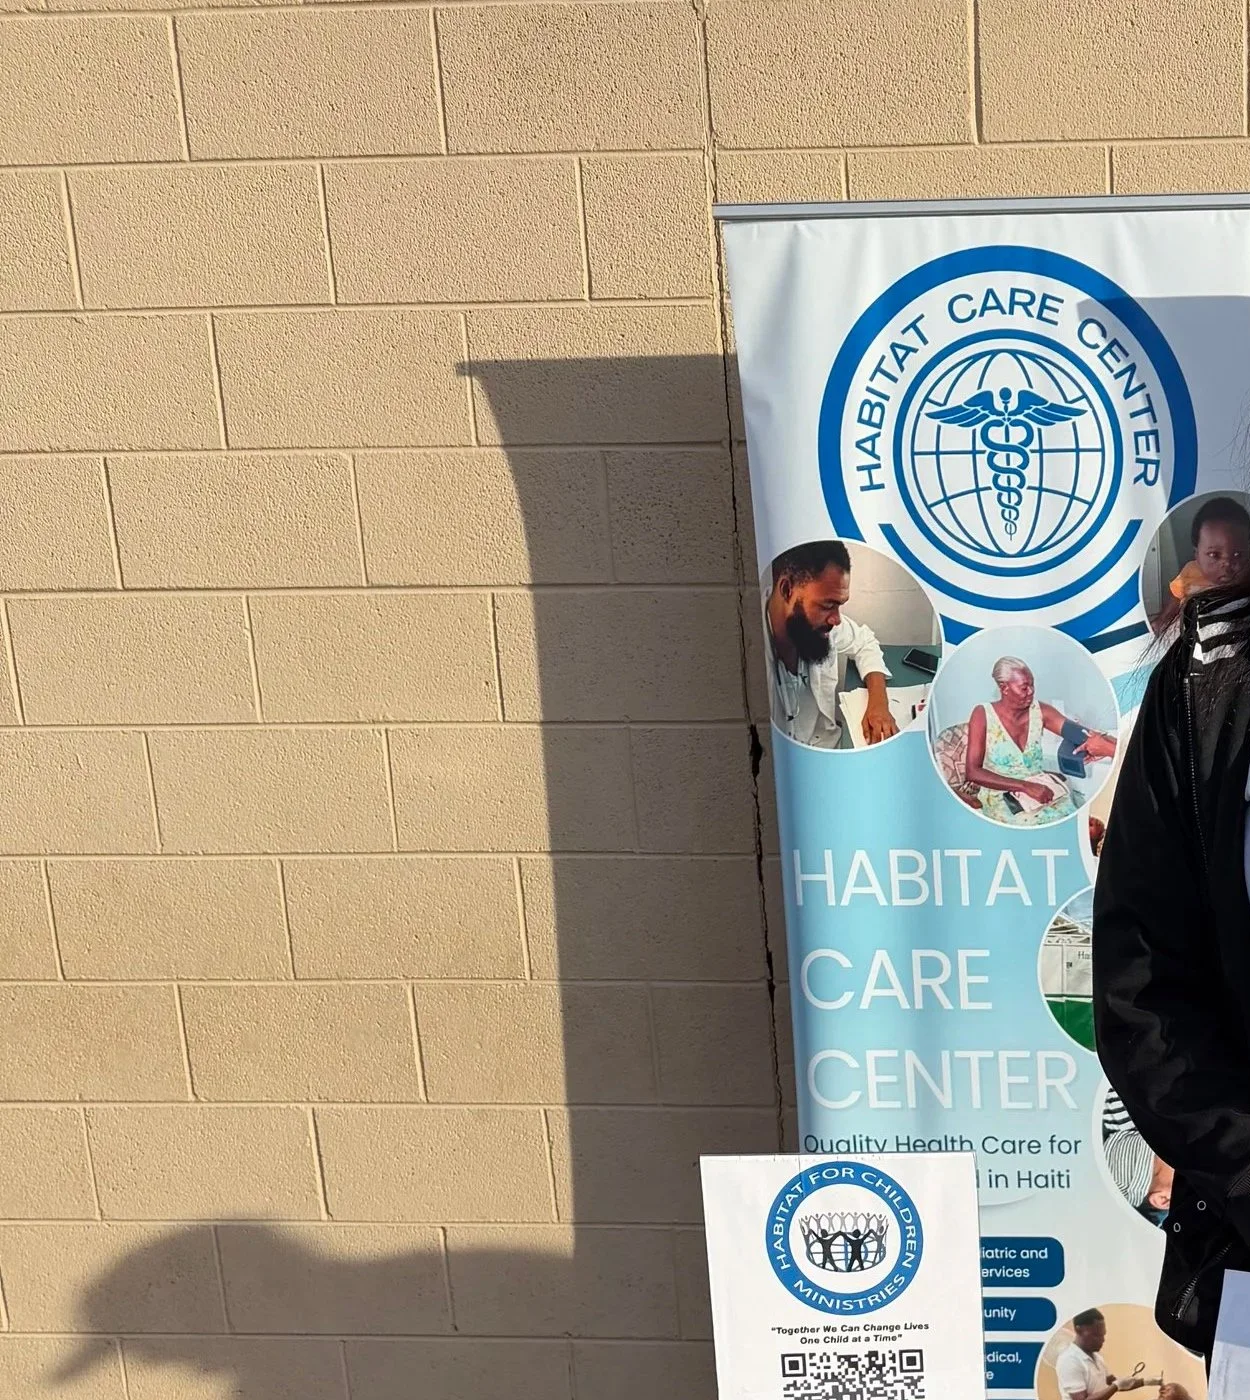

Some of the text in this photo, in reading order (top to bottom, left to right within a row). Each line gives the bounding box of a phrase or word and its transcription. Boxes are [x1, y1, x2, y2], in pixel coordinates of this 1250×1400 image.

[856, 286, 1161, 493] HABITAT CARE CENTER
[793, 848, 1069, 907] HABITAT
[801, 948, 993, 1011] CARE
[806, 1049, 1079, 1110] CENTER
[803, 1133, 1082, 1156] Quality Health Care for
[988, 1170, 1011, 1189] in
[1016, 1169, 1072, 1190] Haiti
[772, 1167, 917, 1270] HABITAT FOR CHILDREN
[981, 1247, 1049, 1260] iatric and
[981, 1267, 1030, 1278] ervices
[793, 1274, 906, 1311] MINISTRIES
[984, 1307, 1017, 1321] unity
[823, 1324, 837, 1333] We
[840, 1324, 860, 1333] Can
[863, 1323, 901, 1334] Change
[904, 1322, 930, 1331] Lives
[800, 1336, 820, 1345] One
[823, 1335, 849, 1344] Child
[986, 1352, 1022, 1364] dical,
